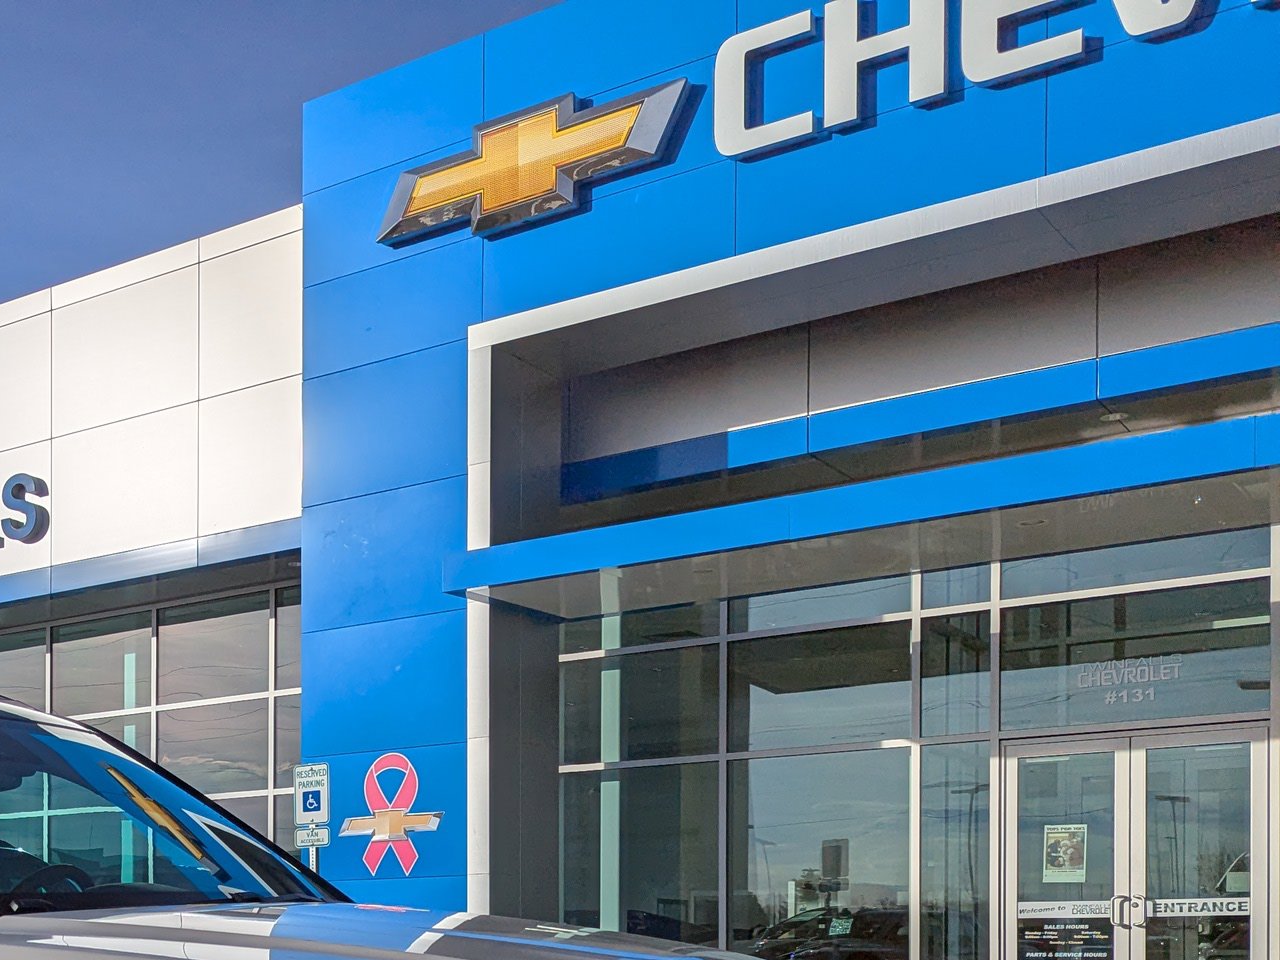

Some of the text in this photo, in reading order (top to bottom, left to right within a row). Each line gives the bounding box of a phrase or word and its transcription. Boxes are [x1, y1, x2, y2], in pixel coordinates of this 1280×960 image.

[1077, 663, 1183, 688] CHEVROLET
[1104, 687, 1156, 705] #131
[296, 768, 327, 779] RESERVED
[298, 779, 325, 790] PARKING
[1019, 906, 1055, 915] Welcome
[1153, 901, 1249, 914] ENTRANCE
